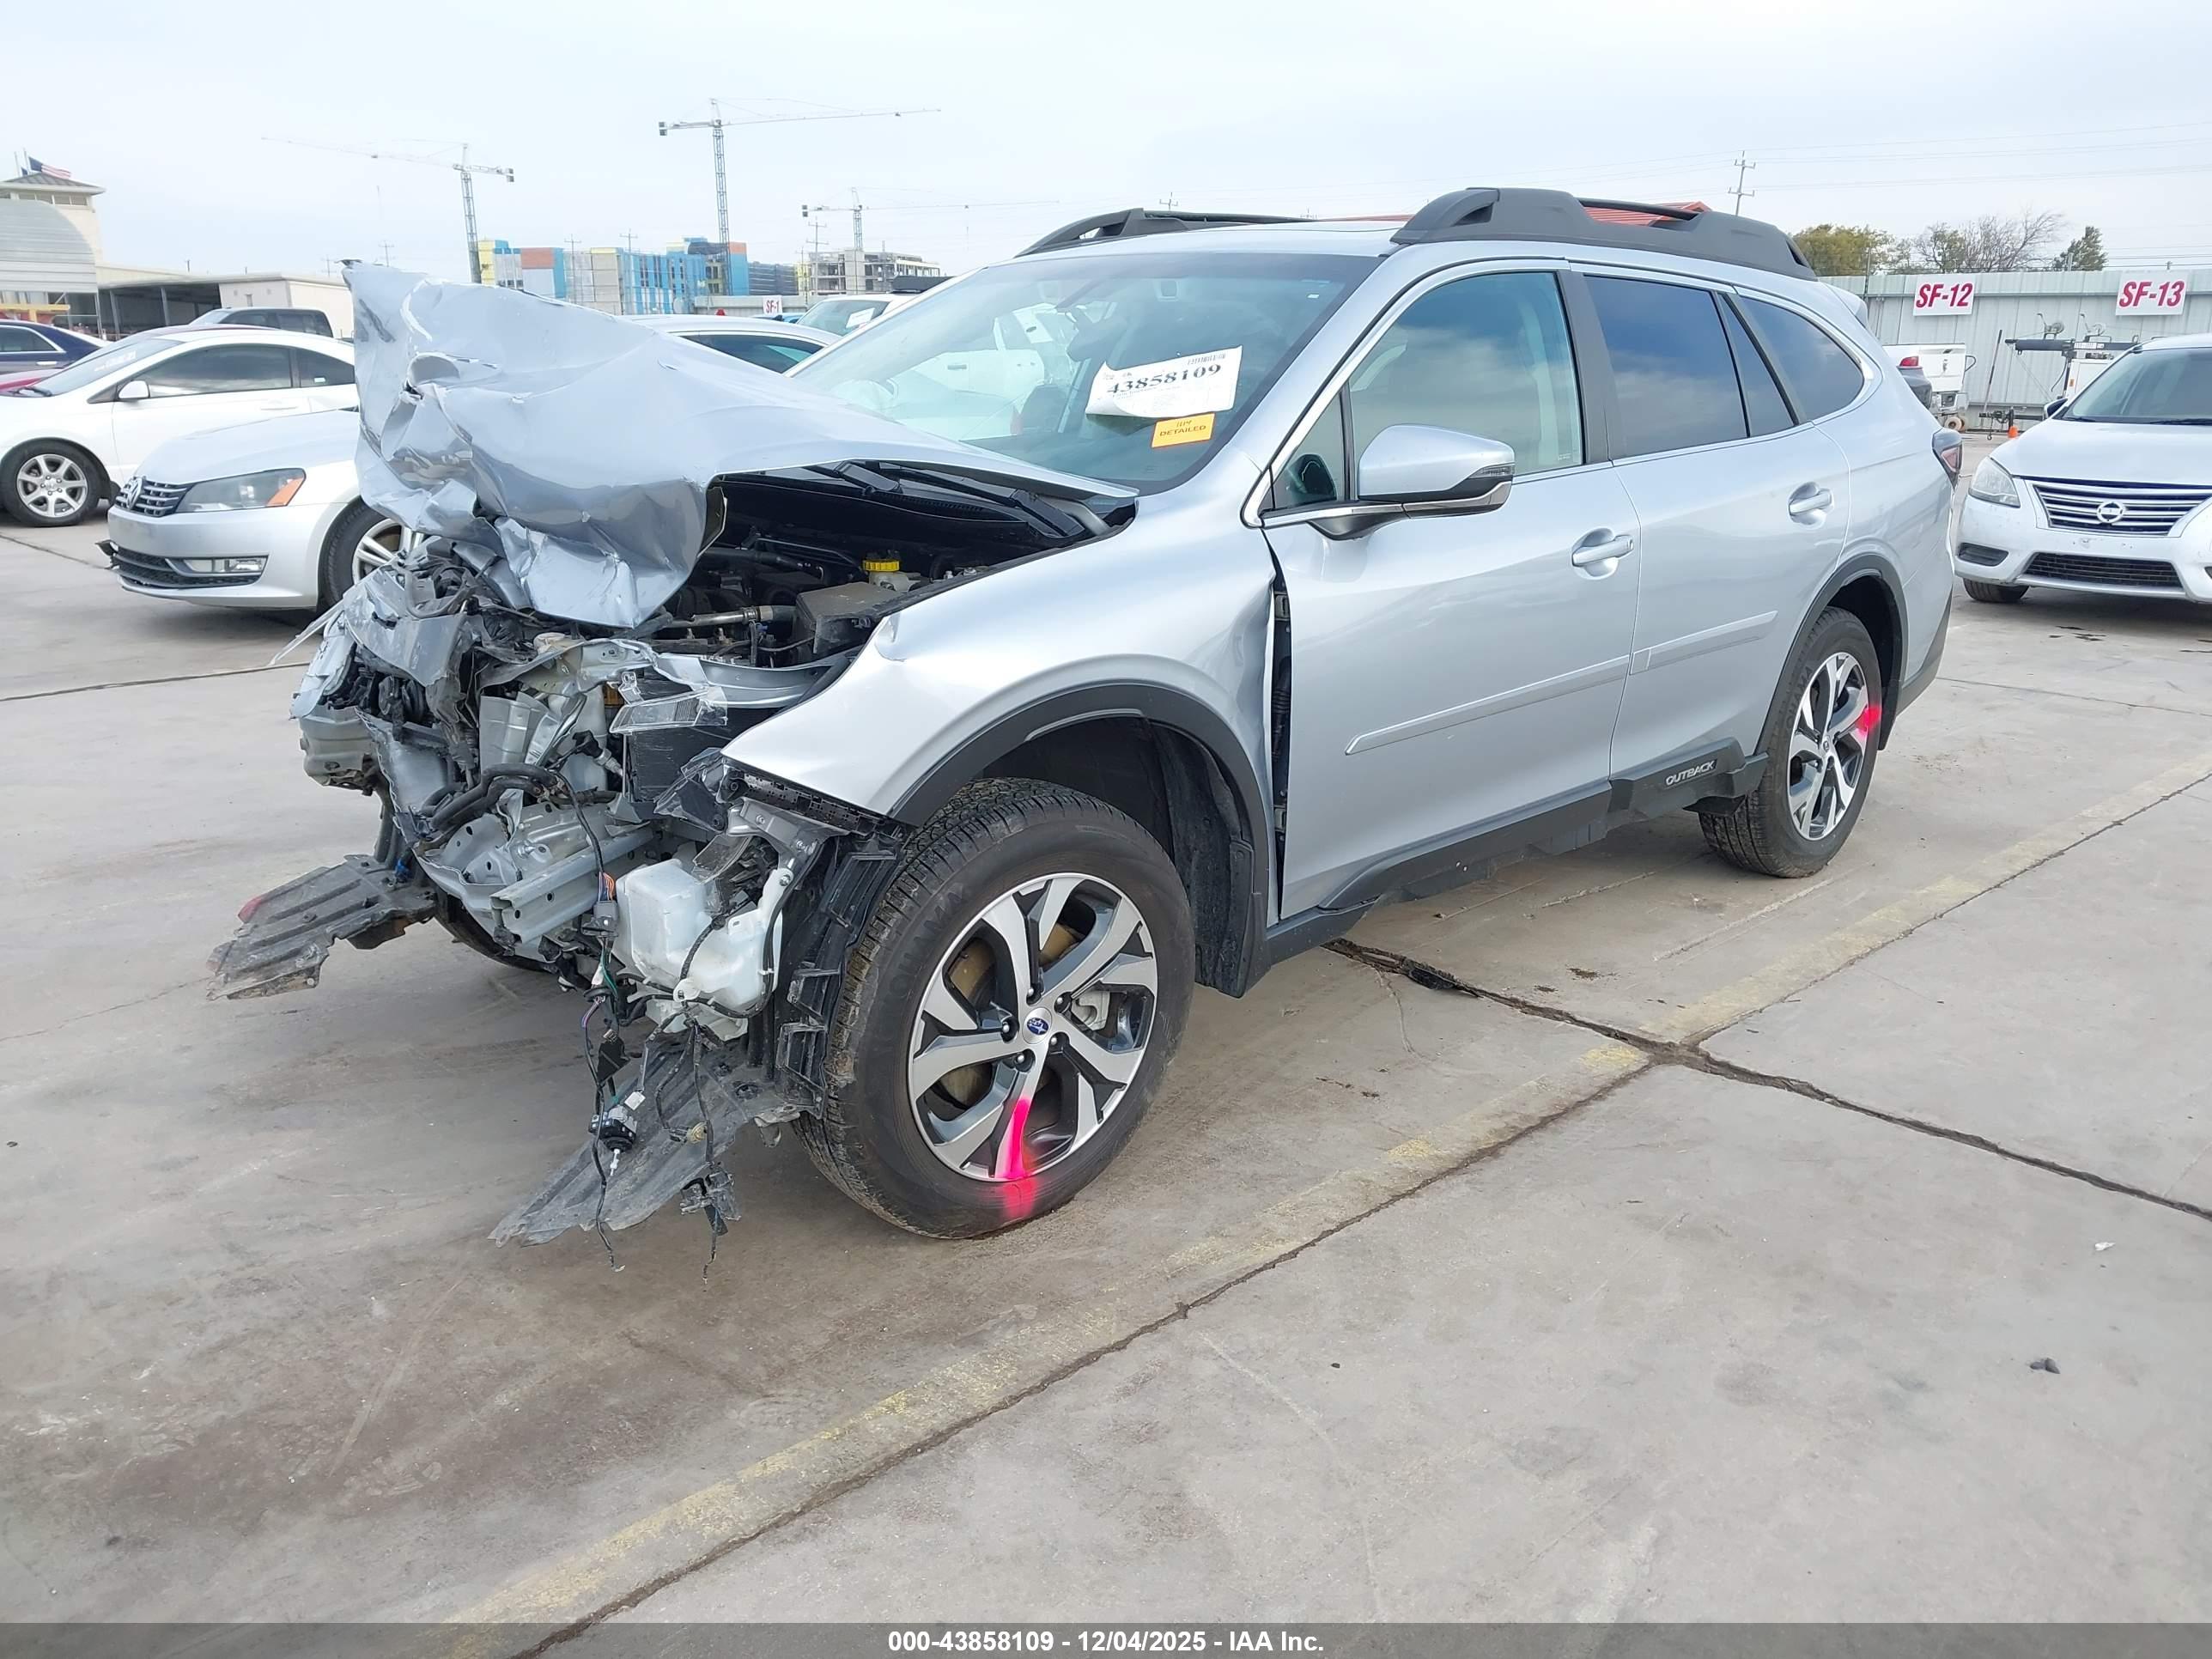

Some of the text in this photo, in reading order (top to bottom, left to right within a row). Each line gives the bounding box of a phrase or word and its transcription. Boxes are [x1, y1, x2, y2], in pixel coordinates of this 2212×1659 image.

[1916, 282, 1973, 308] SF-12
[2118, 280, 2185, 307] SF-13
[766, 300, 780, 314] SF-1
[1107, 364, 1221, 393] 43858109
[1159, 425, 1206, 436] DETAILED
[1666, 760, 1716, 786] OUTBACK
